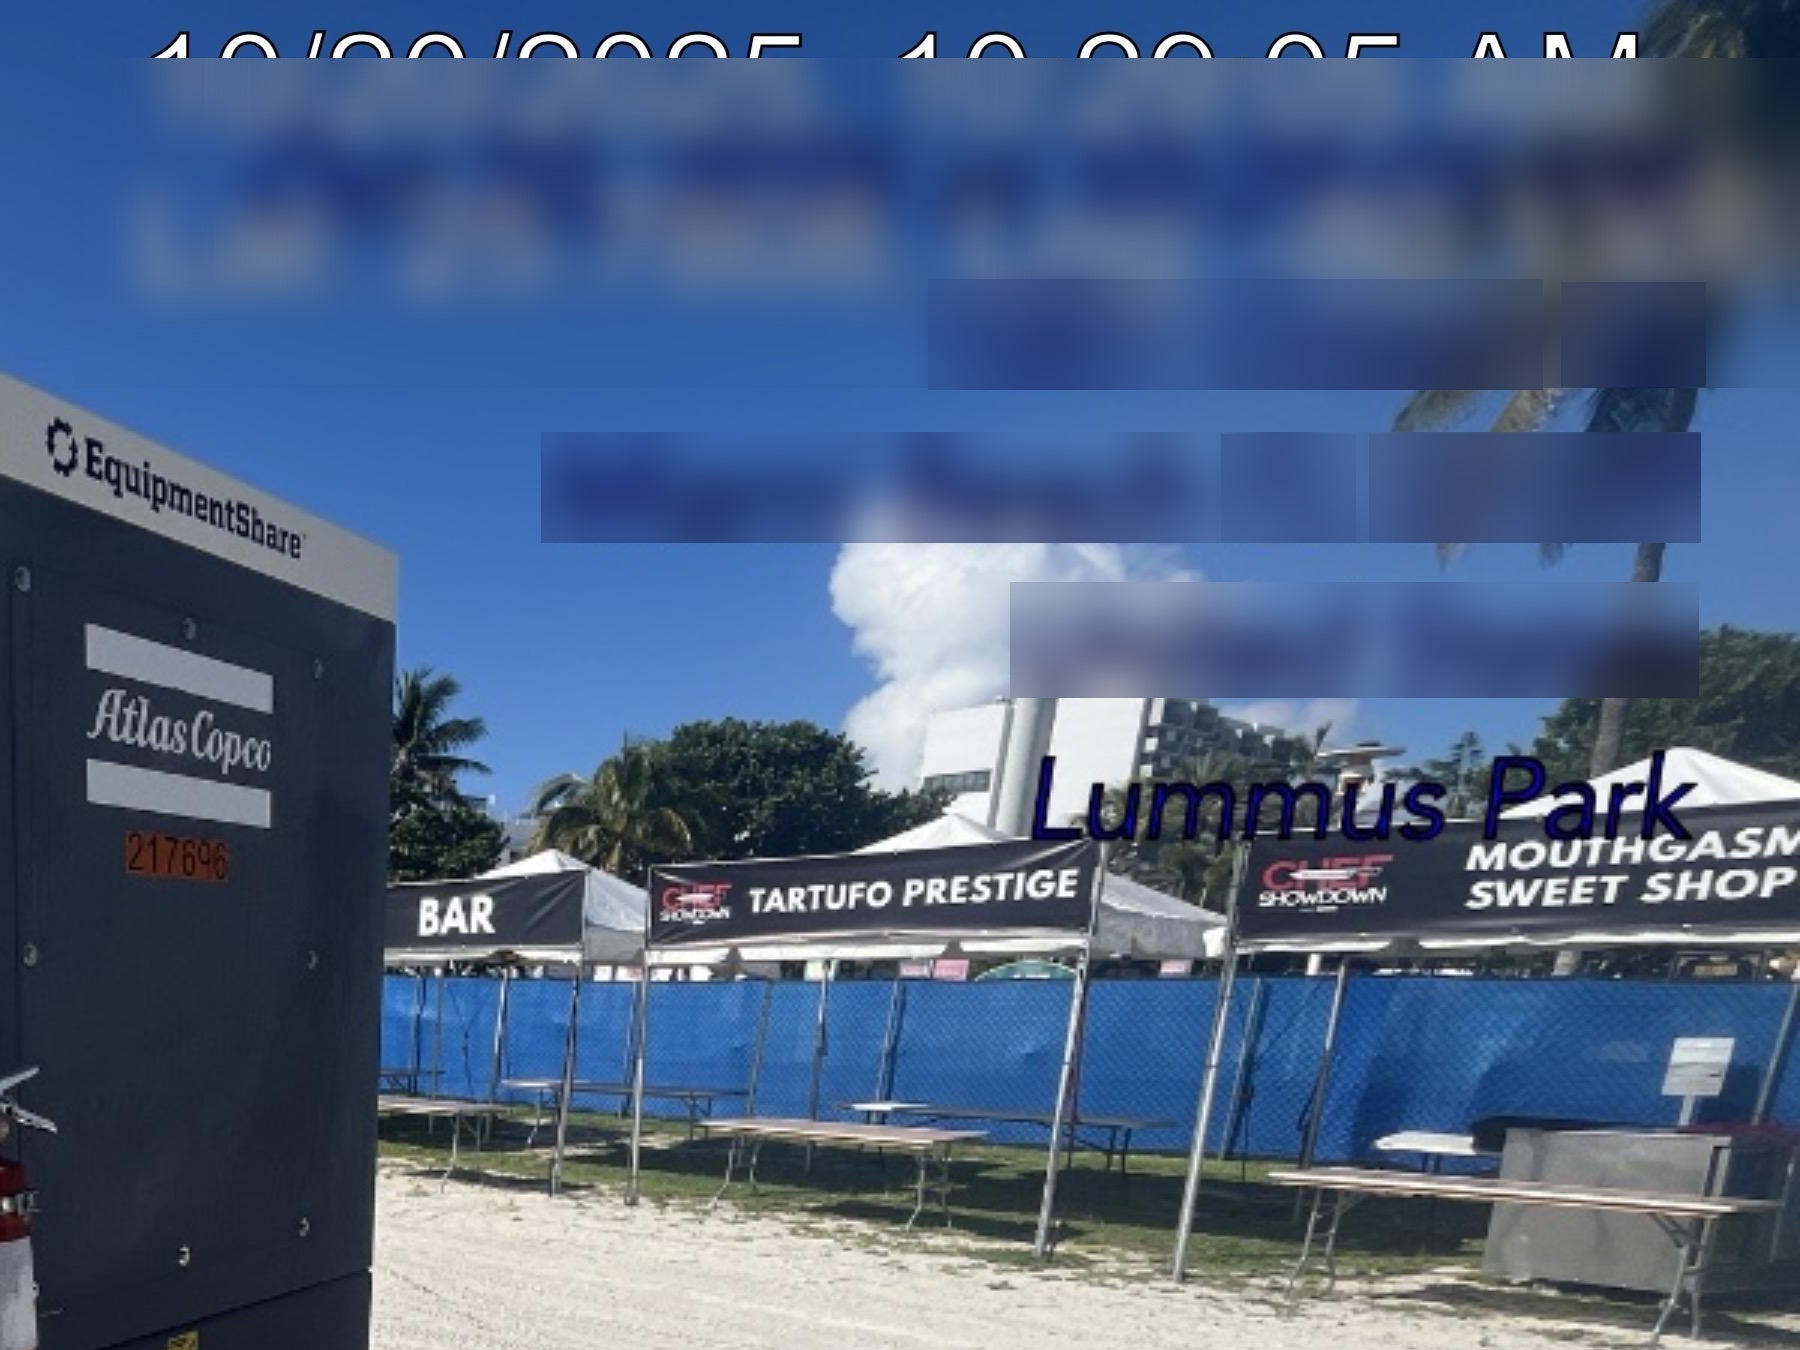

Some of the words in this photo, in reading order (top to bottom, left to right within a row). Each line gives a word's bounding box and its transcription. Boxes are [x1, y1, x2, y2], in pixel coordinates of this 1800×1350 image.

[85, 436, 302, 559] EquipmentShare
[87, 689, 187, 755] Atlas
[191, 710, 271, 775] Copco
[127, 832, 228, 881] 217696
[749, 881, 893, 914] TARTUFO
[902, 868, 1080, 907] PRESTIGE
[1258, 886, 1388, 908] SHOWDOWN
[1464, 874, 1630, 911] SWEET
[1640, 865, 1798, 902] SHOP
[417, 894, 496, 937] BAR
